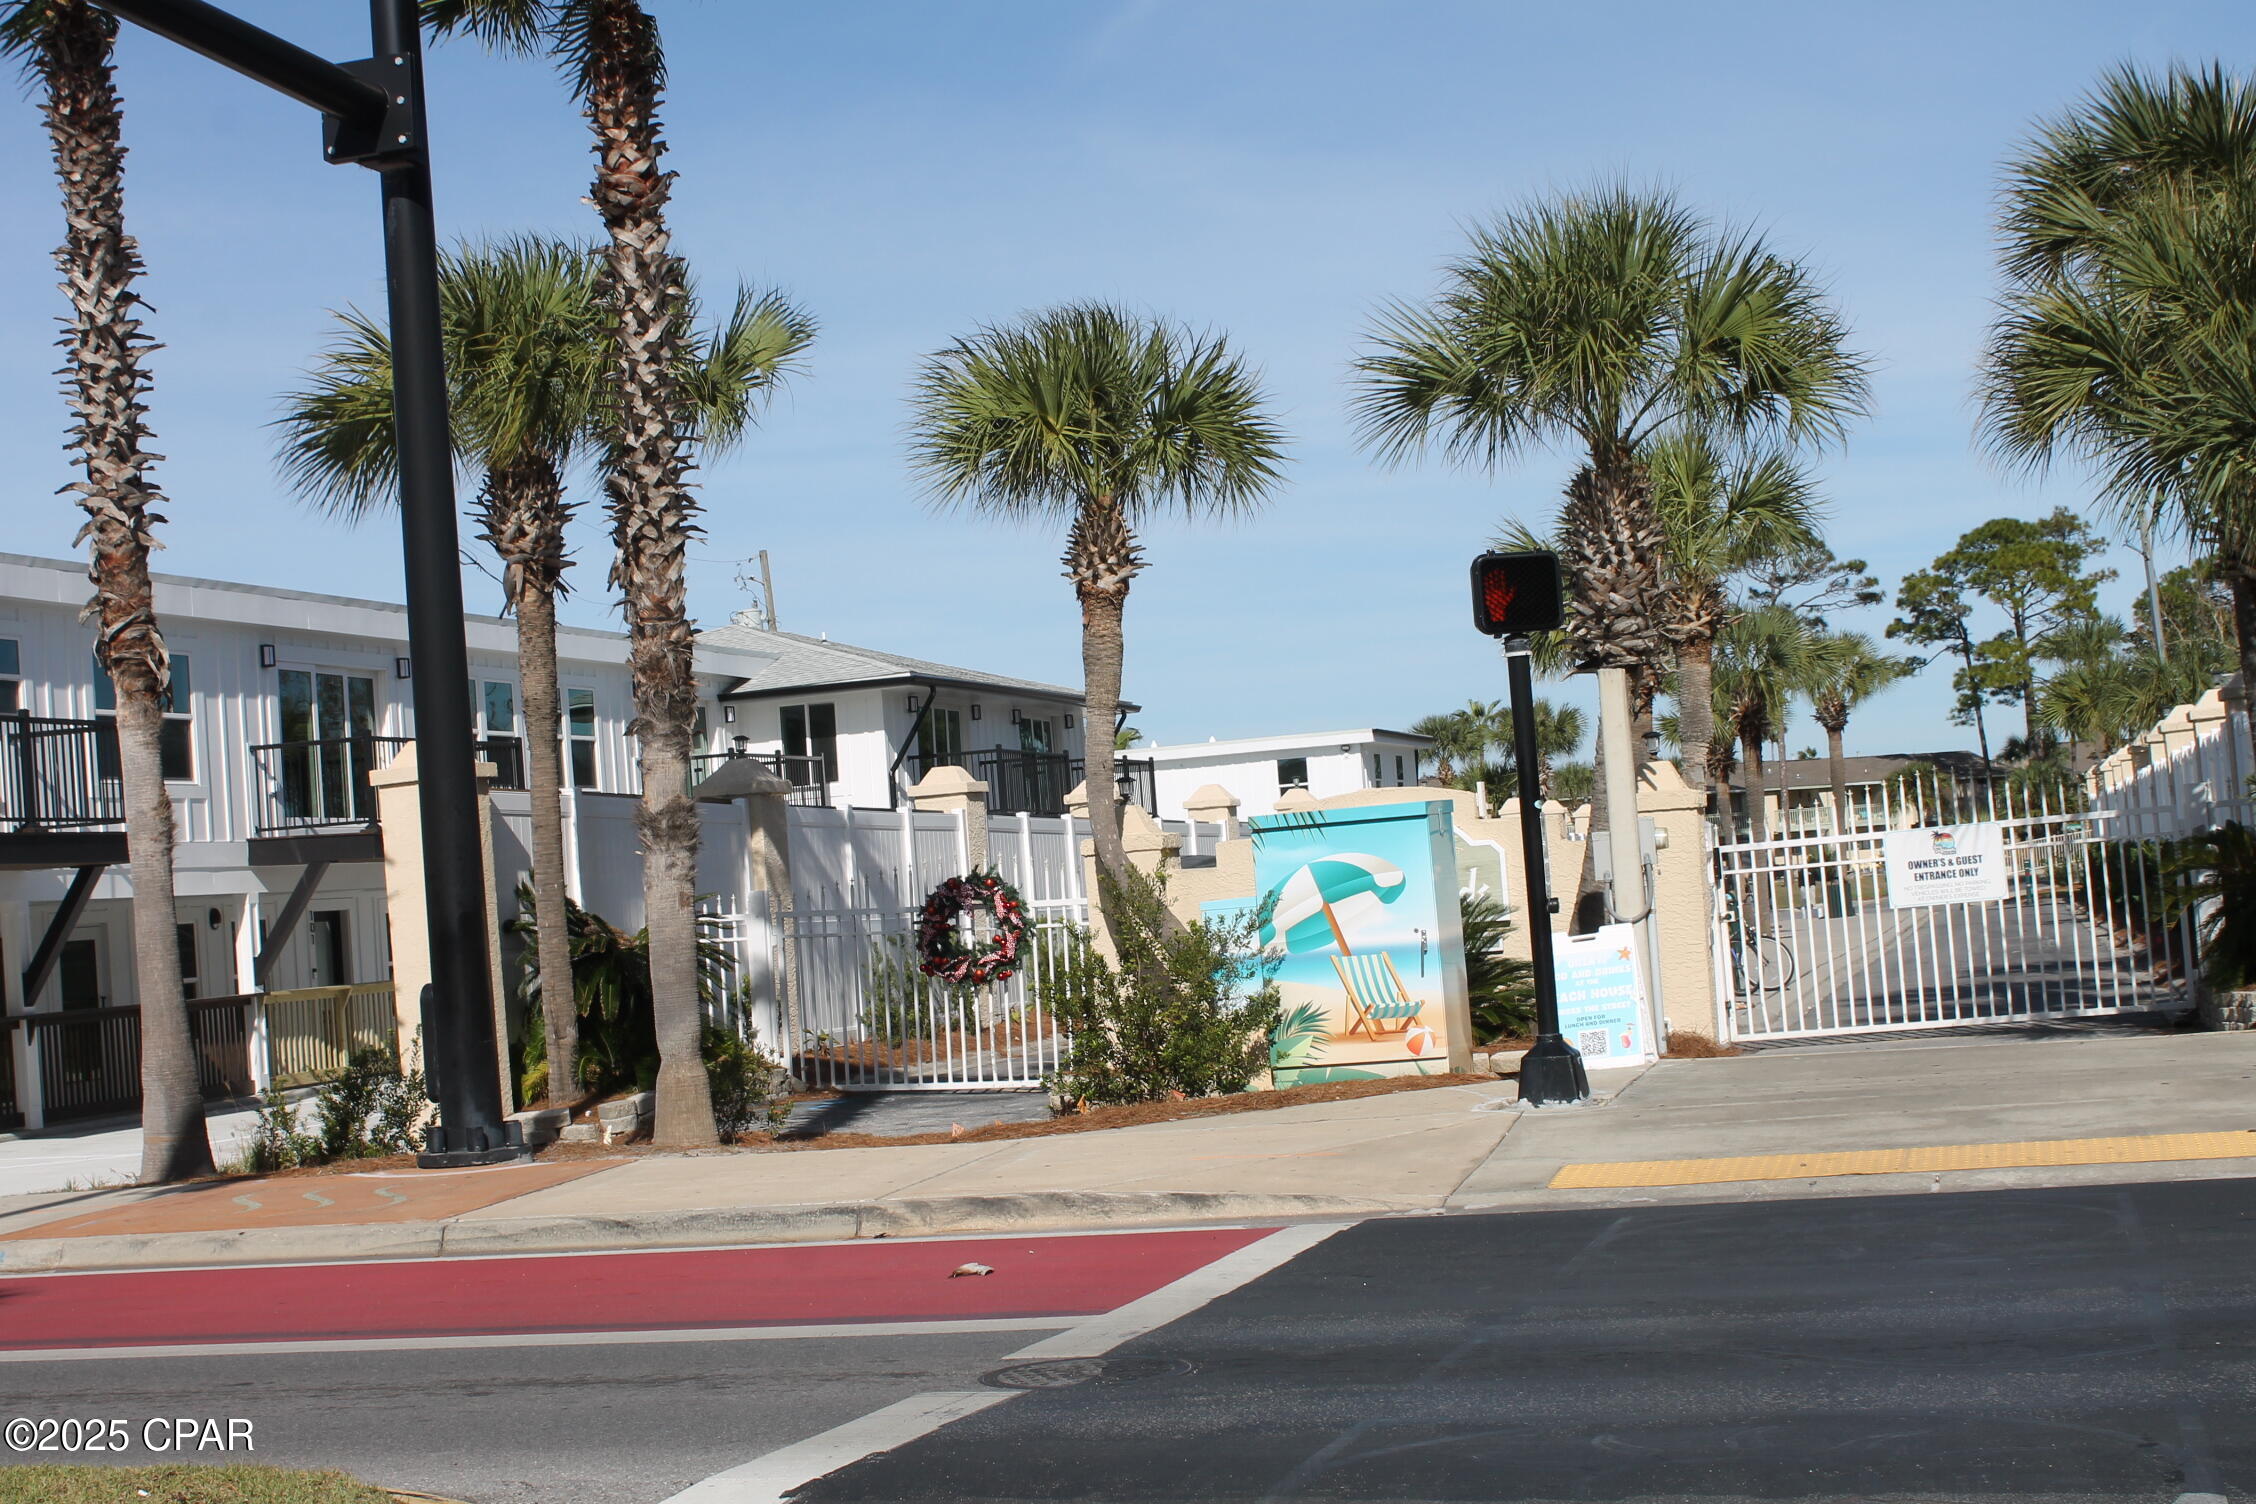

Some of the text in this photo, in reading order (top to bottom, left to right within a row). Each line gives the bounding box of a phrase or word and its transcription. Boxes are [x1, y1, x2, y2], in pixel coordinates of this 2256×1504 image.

[1908, 855, 1983, 870] OWNER'S & GUEST
[1914, 867, 1979, 881] ENTRANCE ONLY
[1910, 889, 1939, 897] VEHICLES
[1564, 1017, 1622, 1030] LUNCH AND DINNER
